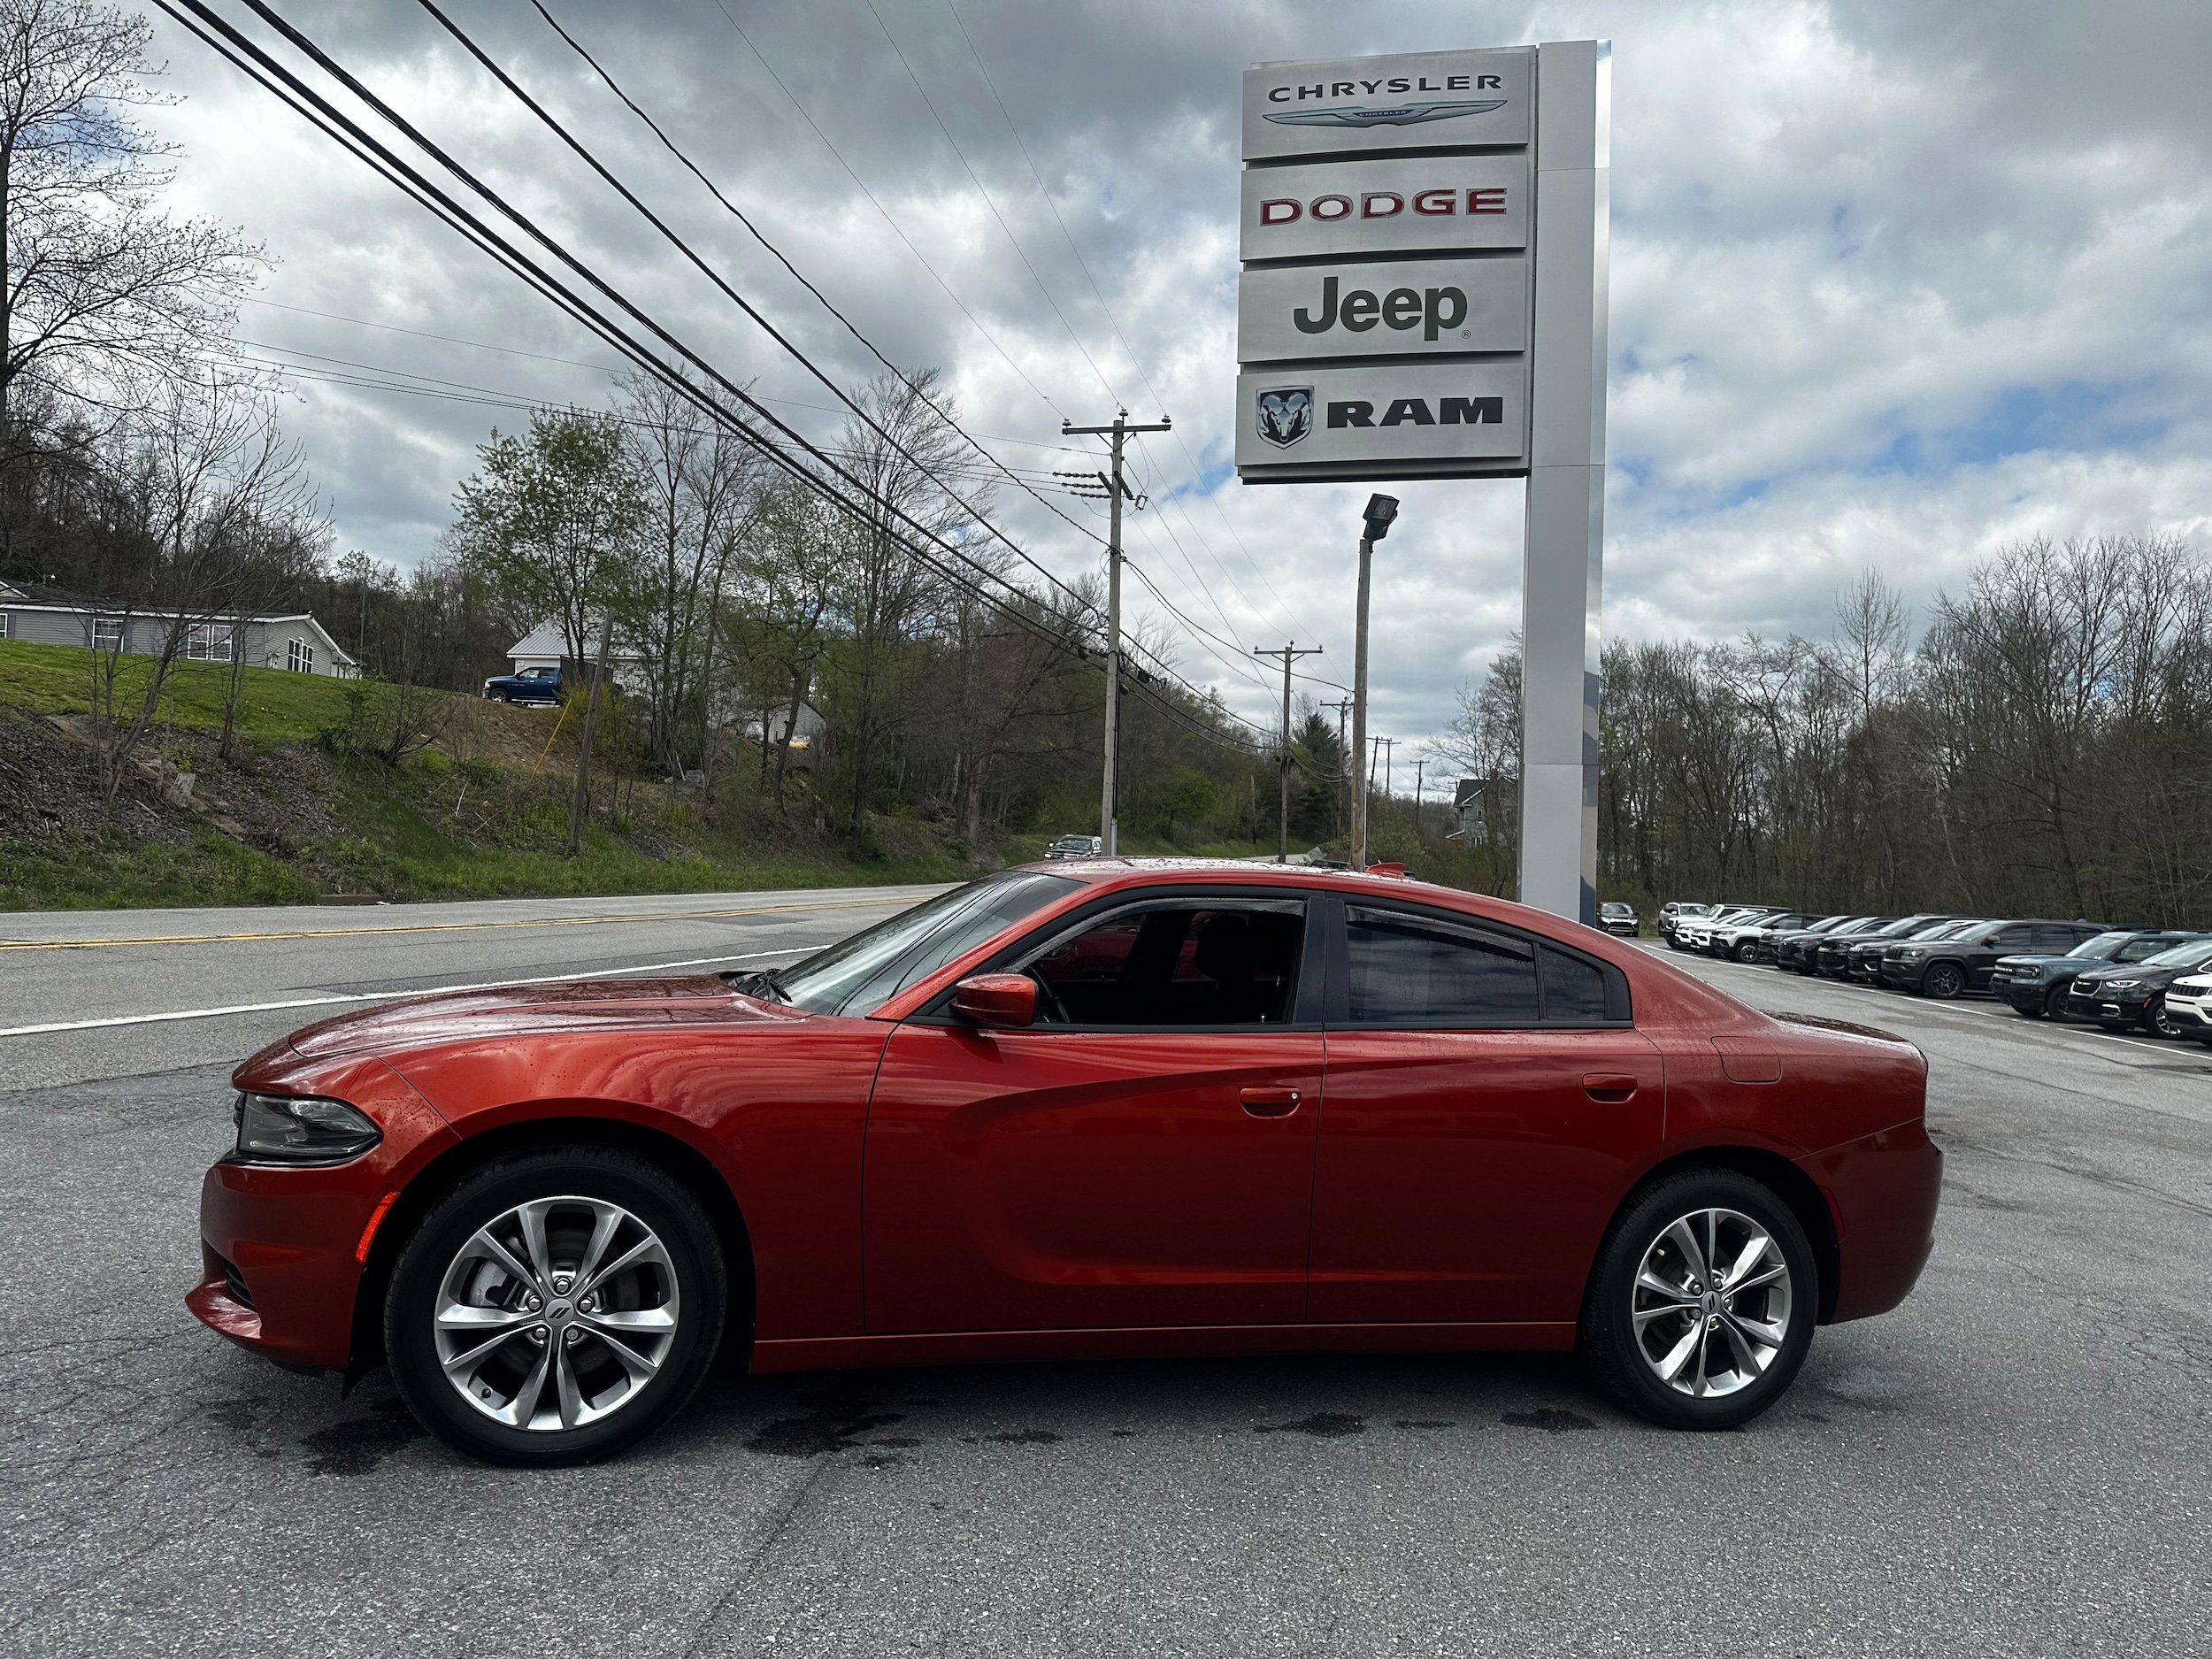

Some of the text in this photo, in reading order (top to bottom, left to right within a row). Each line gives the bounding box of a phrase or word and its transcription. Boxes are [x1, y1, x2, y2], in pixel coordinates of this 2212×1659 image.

[1268, 74, 1502, 103] CHRYSLER
[1259, 188, 1508, 227] DODGE
[1293, 276, 1468, 342] Jeep
[1326, 396, 1503, 429] RAM
